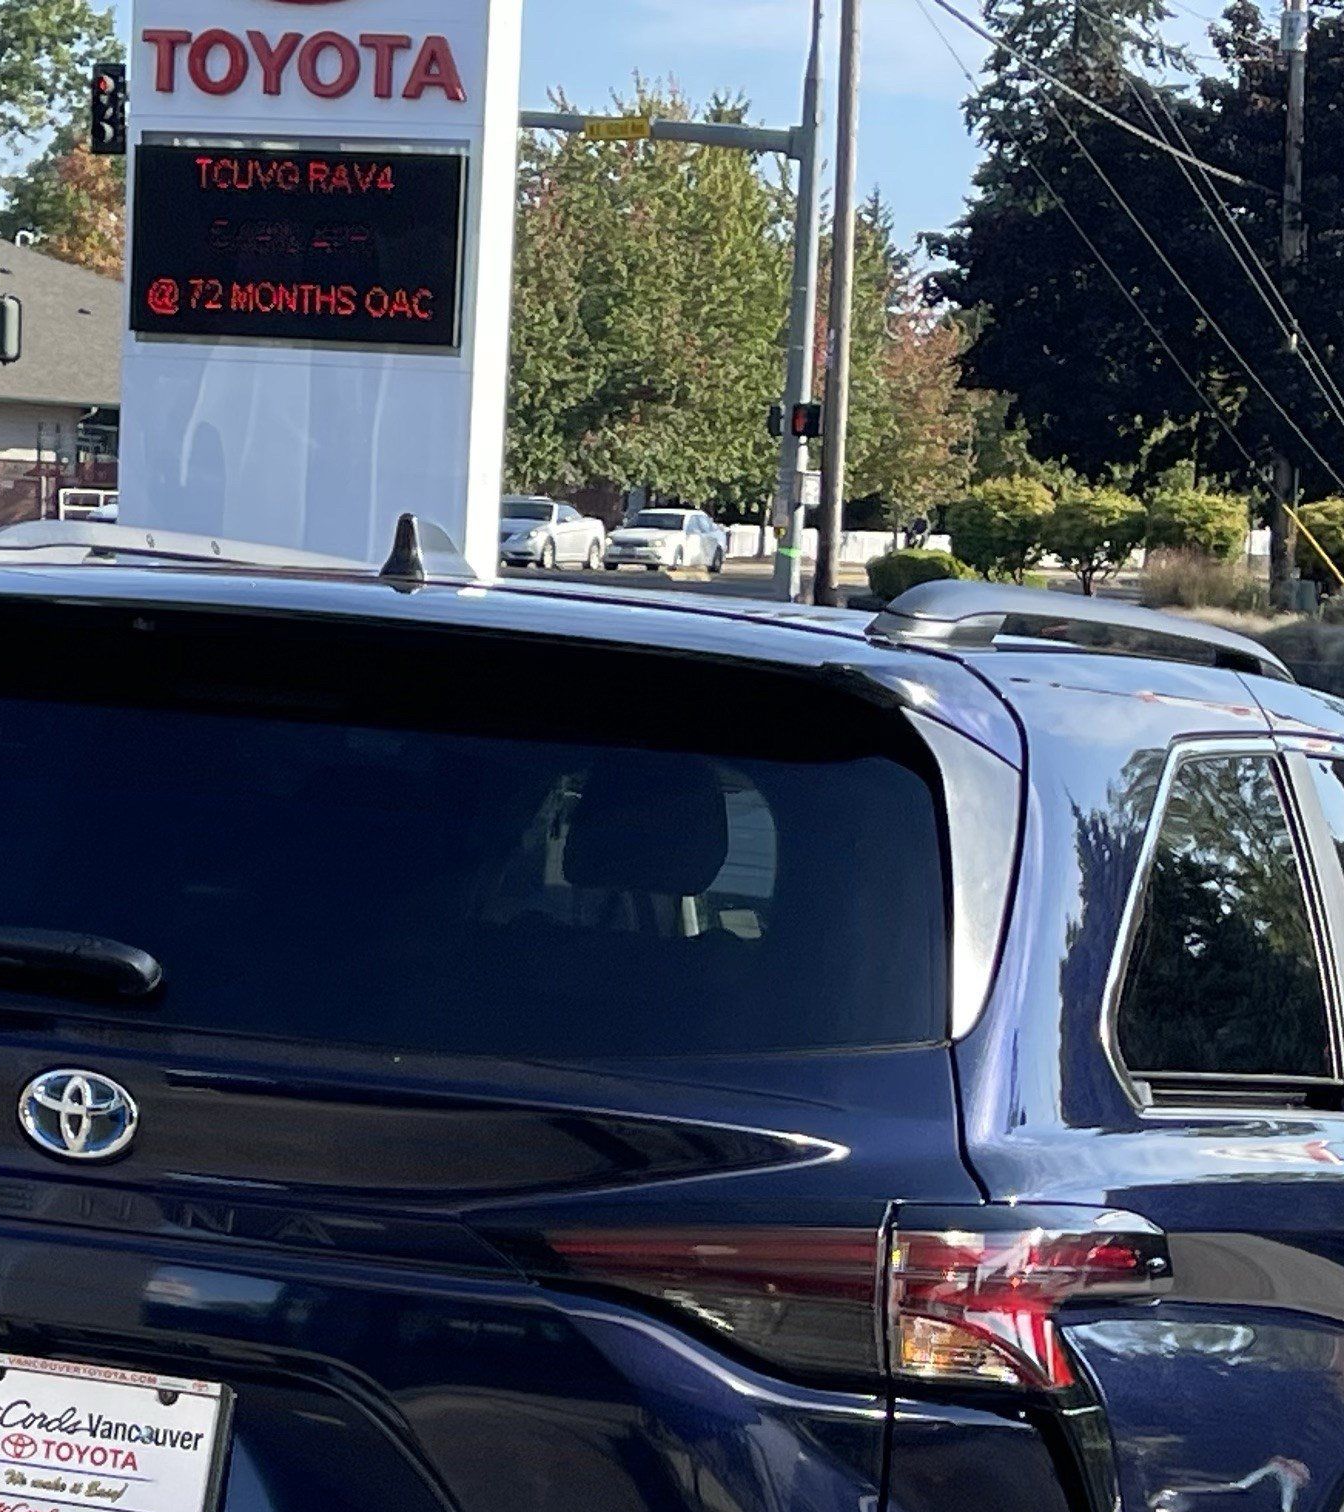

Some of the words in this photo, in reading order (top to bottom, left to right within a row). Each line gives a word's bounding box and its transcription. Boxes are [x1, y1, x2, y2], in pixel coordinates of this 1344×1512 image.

[142, 28, 468, 103] TOYOTA
[308, 159, 395, 194] RAV4
[147, 279, 180, 316] @
[188, 279, 223, 310] 72
[230, 282, 357, 317] MONTHS
[364, 285, 434, 321] OAC
[42, 1439, 139, 1472] TOYOTA
